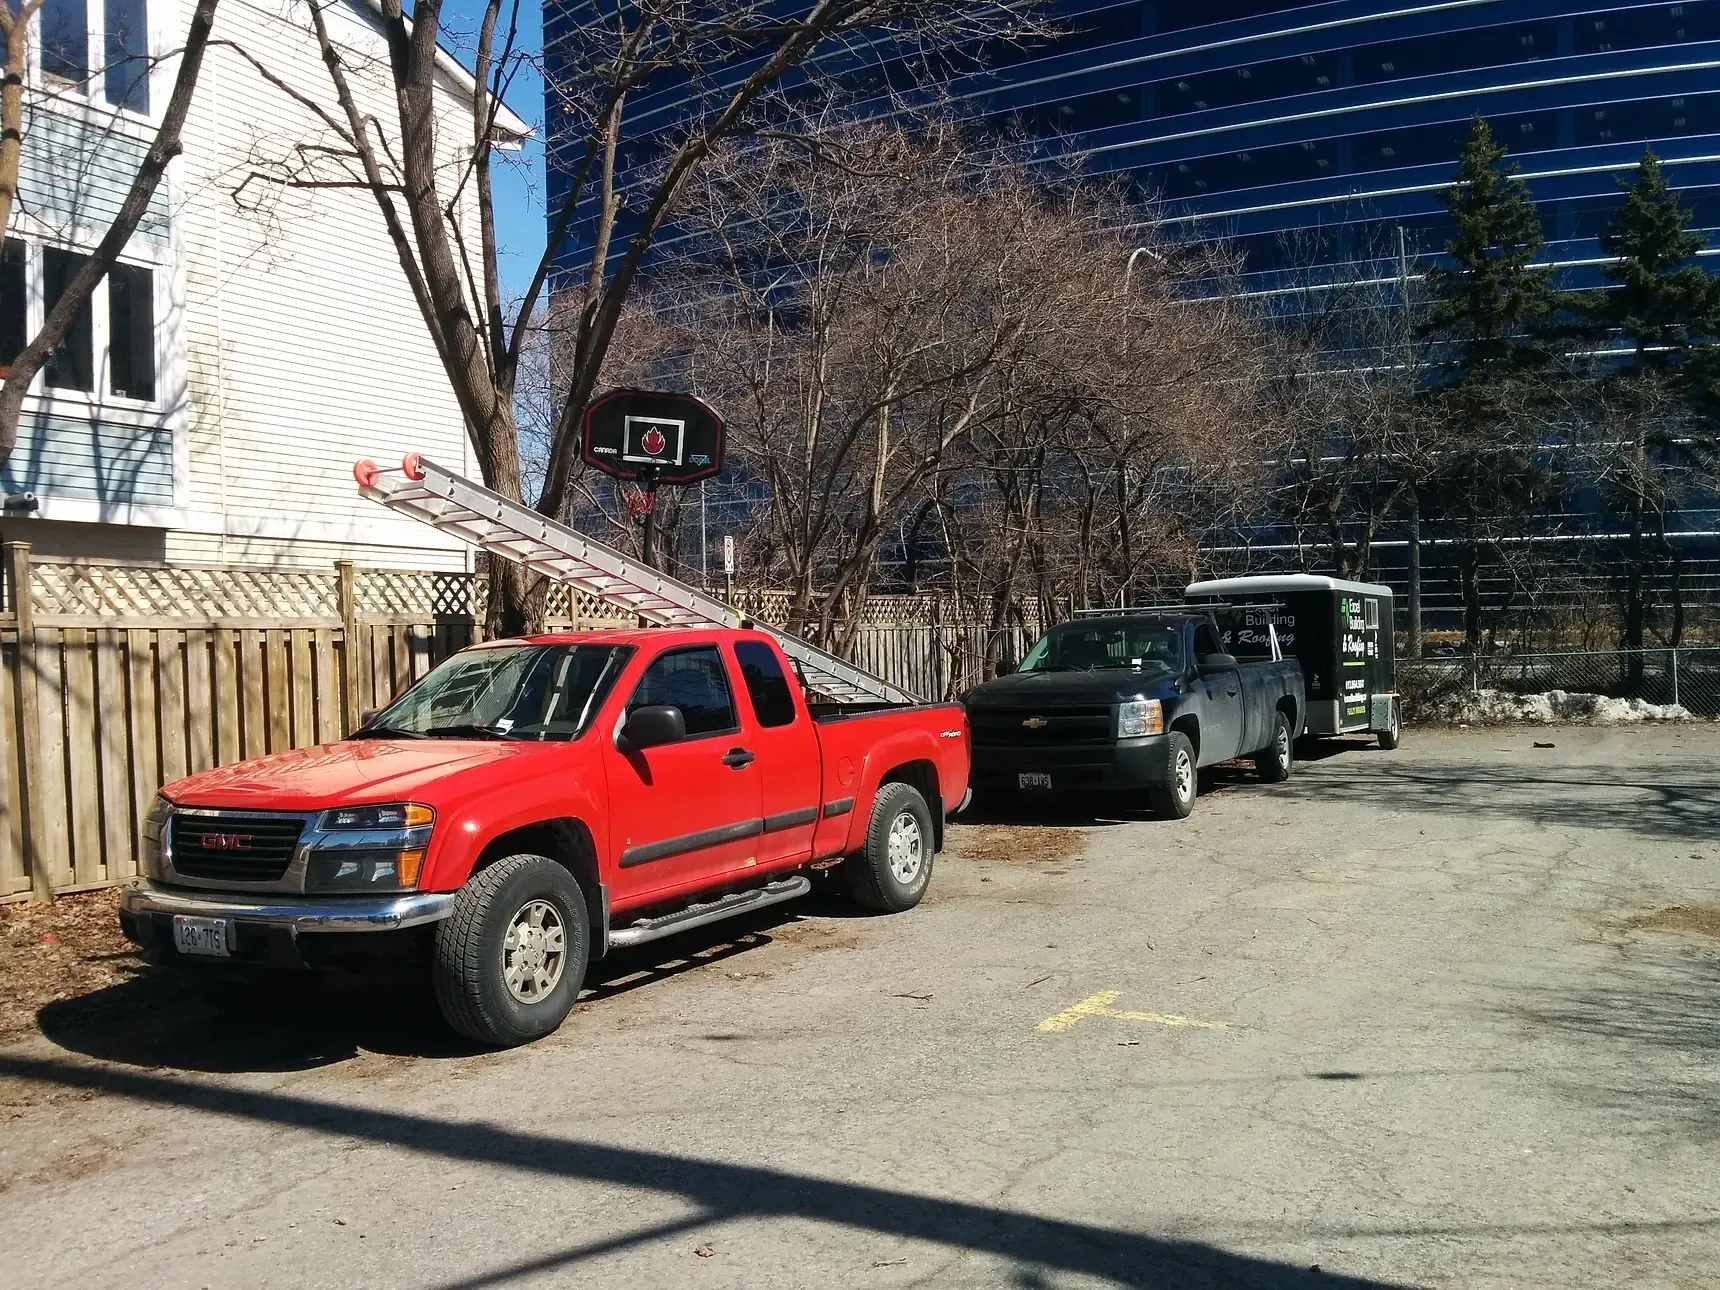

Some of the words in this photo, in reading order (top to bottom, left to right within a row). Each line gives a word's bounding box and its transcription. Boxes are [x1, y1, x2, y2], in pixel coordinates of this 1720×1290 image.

[594, 446, 618, 454] CANADA
[1221, 630, 1232, 644] &
[202, 833, 252, 850] GMC
